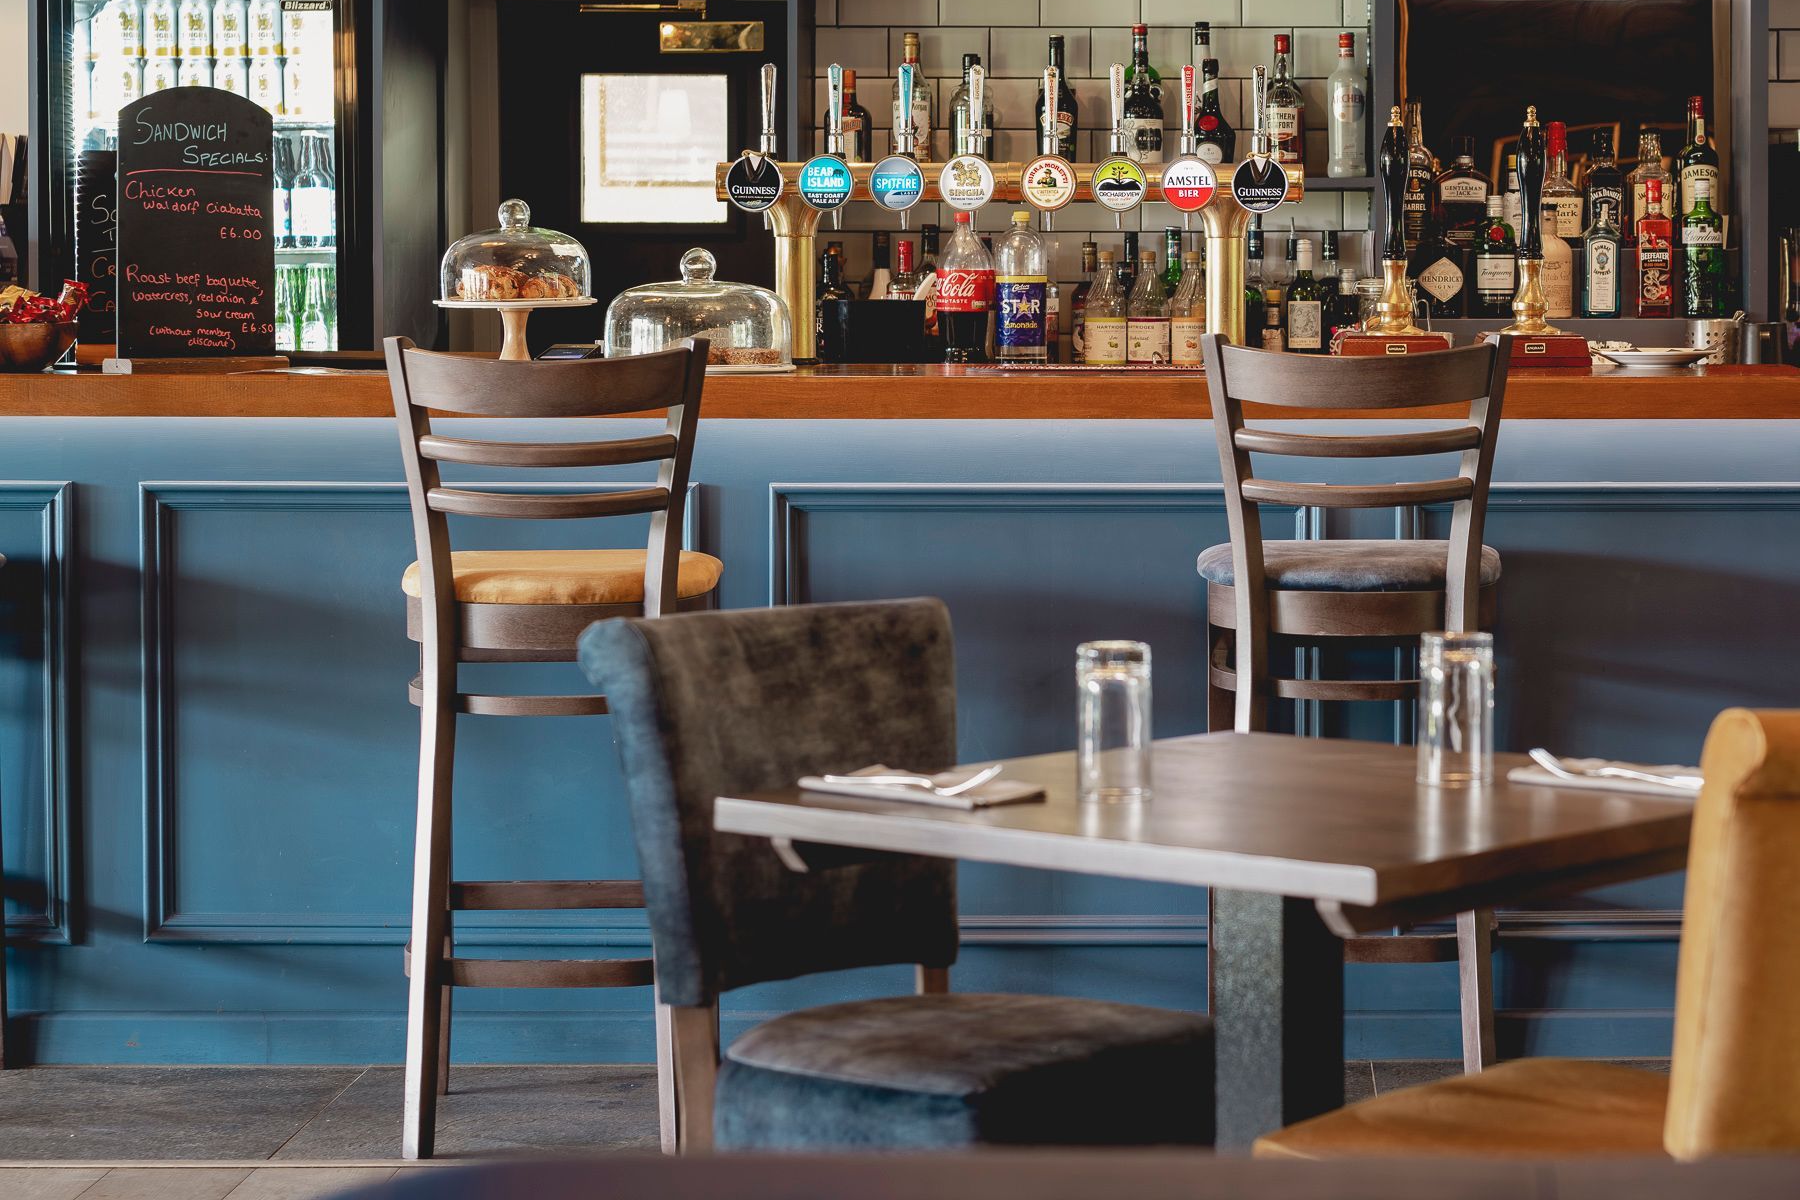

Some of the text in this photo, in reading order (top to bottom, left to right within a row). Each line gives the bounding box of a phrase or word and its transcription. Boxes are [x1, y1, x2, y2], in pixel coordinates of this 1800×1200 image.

[284, 1, 326, 10] Blizzard
[133, 106, 227, 145] SANDWICH
[182, 145, 268, 167] SPECIALS:
[807, 167, 834, 177] BEAR
[1044, 163, 1069, 184] MORETTI
[1683, 168, 1718, 180] JAMESON
[807, 177, 844, 188] ISLAND
[876, 177, 917, 190] SPITFIRE
[1167, 176, 1211, 186] AMSTEL
[125, 180, 196, 200] Chicken
[731, 184, 777, 195] GUINNESS
[948, 189, 985, 197] SINGHA
[1178, 189, 1199, 198] BIER
[1237, 187, 1282, 197] GUINNESS
[1640, 252, 1669, 260] BEEFEATER
[126, 263, 171, 284] Roast
[176, 273, 200, 287] beef
[196, 293, 214, 302] red
[215, 293, 246, 304] onion
[225, 311, 255, 320] cream
[149, 325, 192, 336] (without
